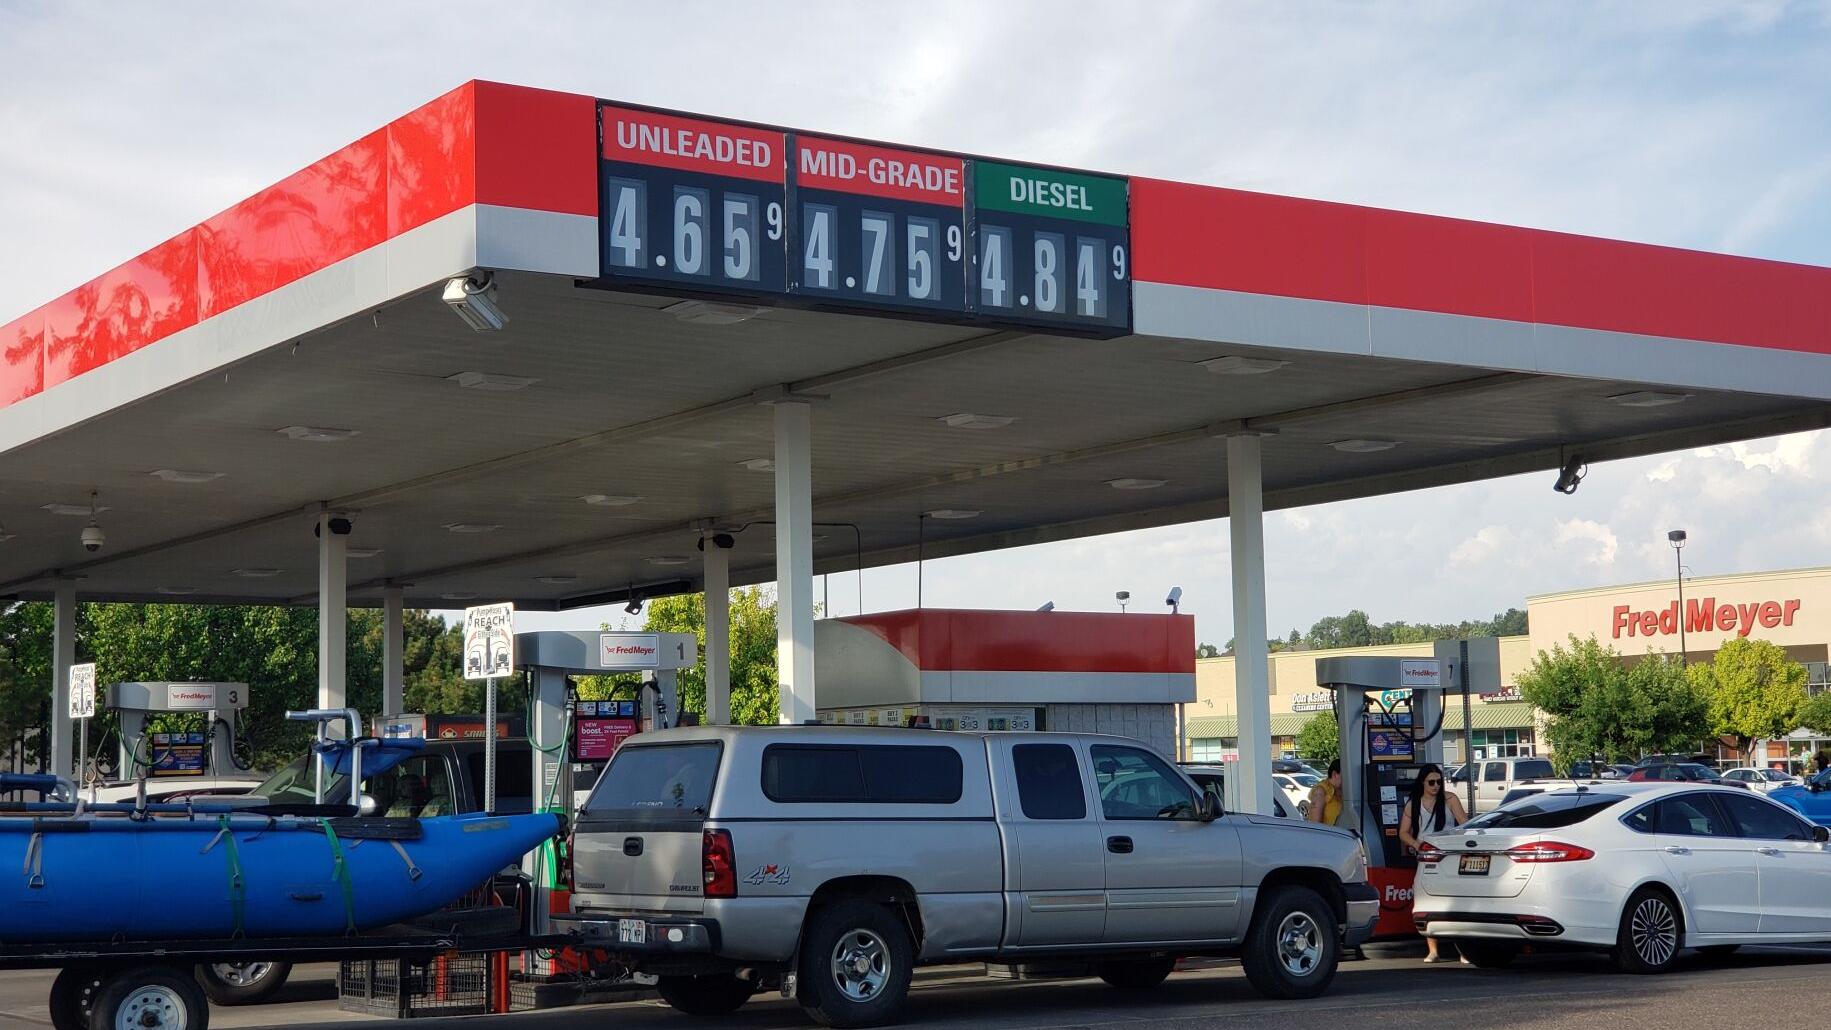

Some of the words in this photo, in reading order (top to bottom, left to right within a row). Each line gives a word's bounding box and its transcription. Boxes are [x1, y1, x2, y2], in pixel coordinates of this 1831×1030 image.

[617, 120, 771, 168] UNLEADED
[800, 148, 959, 194] MID-GRADE
[1009, 176, 1093, 211] DIESEL
[610, 186, 751, 279] 4.65
[766, 201, 783, 241] 9
[805, 211, 932, 299] 4.75
[946, 225, 962, 262] 9
[980, 233, 1098, 316] 4.84
[1112, 244, 1125, 280] 9
[474, 615, 505, 629] REACH
[1612, 600, 1679, 639] Fred
[1684, 597, 1801, 638] Meyer
[676, 642, 684, 660] 1
[228, 690, 238, 704] 3
